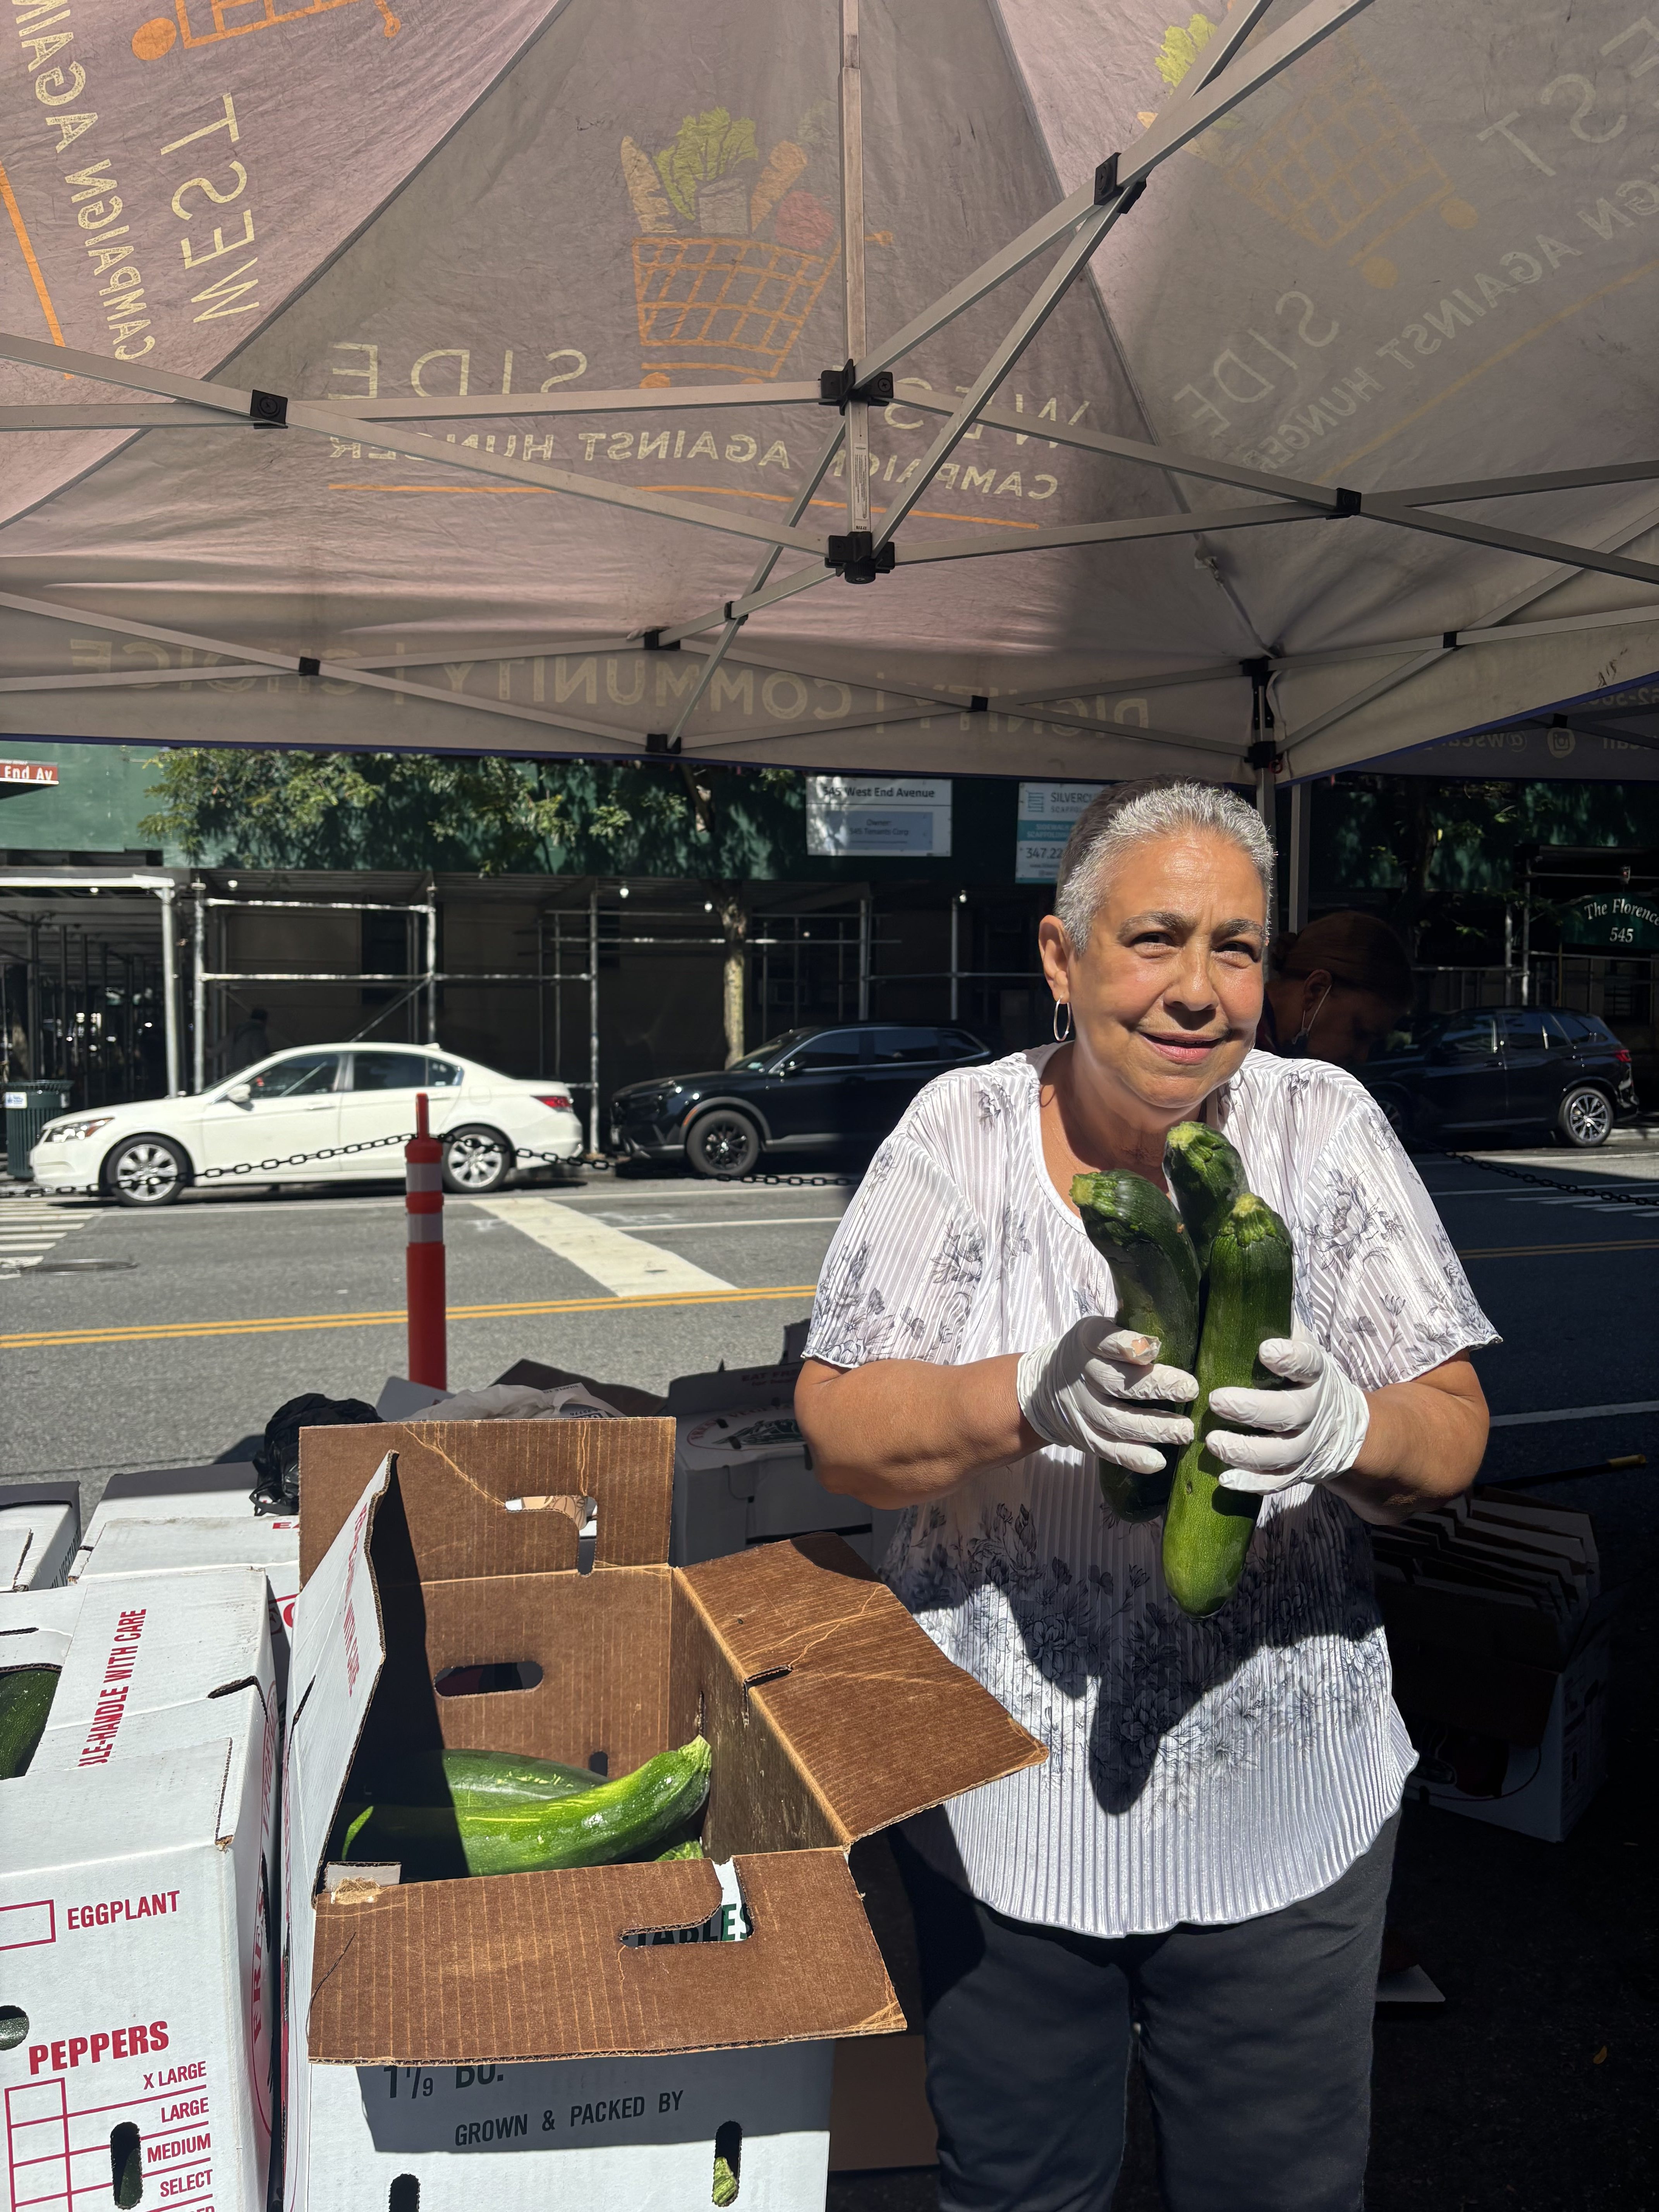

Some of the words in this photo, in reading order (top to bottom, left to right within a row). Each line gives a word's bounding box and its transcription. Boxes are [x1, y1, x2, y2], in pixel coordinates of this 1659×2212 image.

[5, 766, 30, 779] End
[36, 767, 53, 780] Av
[846, 787, 871, 797] West
[874, 787, 894, 797] End
[896, 788, 935, 798] Avenue
[1584, 902, 1607, 921] The
[1612, 898, 1659, 926] Florence
[1609, 927, 1634, 943] 545
[114, 1609, 147, 1643] CARE
[103, 1645, 139, 1683] WITH
[67, 1890, 180, 1930] EGGPLANT
[28, 2020, 170, 2076] PEPPERS
[143, 2073, 154, 2090] X
[158, 2060, 207, 2085] LARGE
[160, 2097, 210, 2123] LARGE
[455, 2112, 528, 2147] GROWN
[542, 2109, 556, 2131] &
[570, 2096, 646, 2128] PACKED
[658, 2090, 684, 2113] BY
[147, 2133, 211, 2164] MEDIUM
[159, 2169, 213, 2198] SELECT
